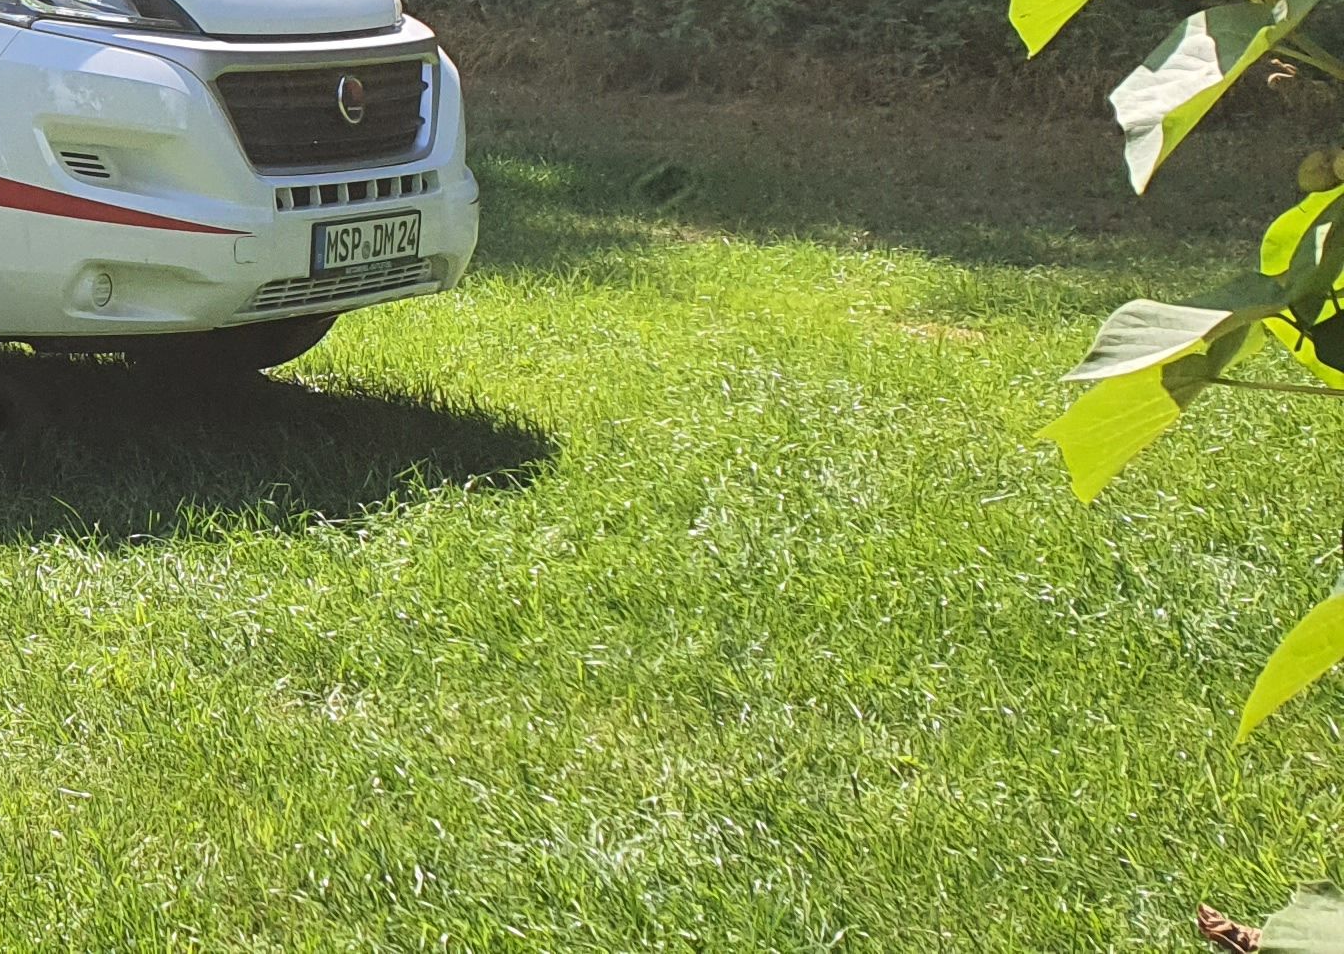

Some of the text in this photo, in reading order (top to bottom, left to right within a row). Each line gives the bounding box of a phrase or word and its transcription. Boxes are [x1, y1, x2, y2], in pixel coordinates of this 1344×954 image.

[326, 218, 417, 264] MSP DM 24
